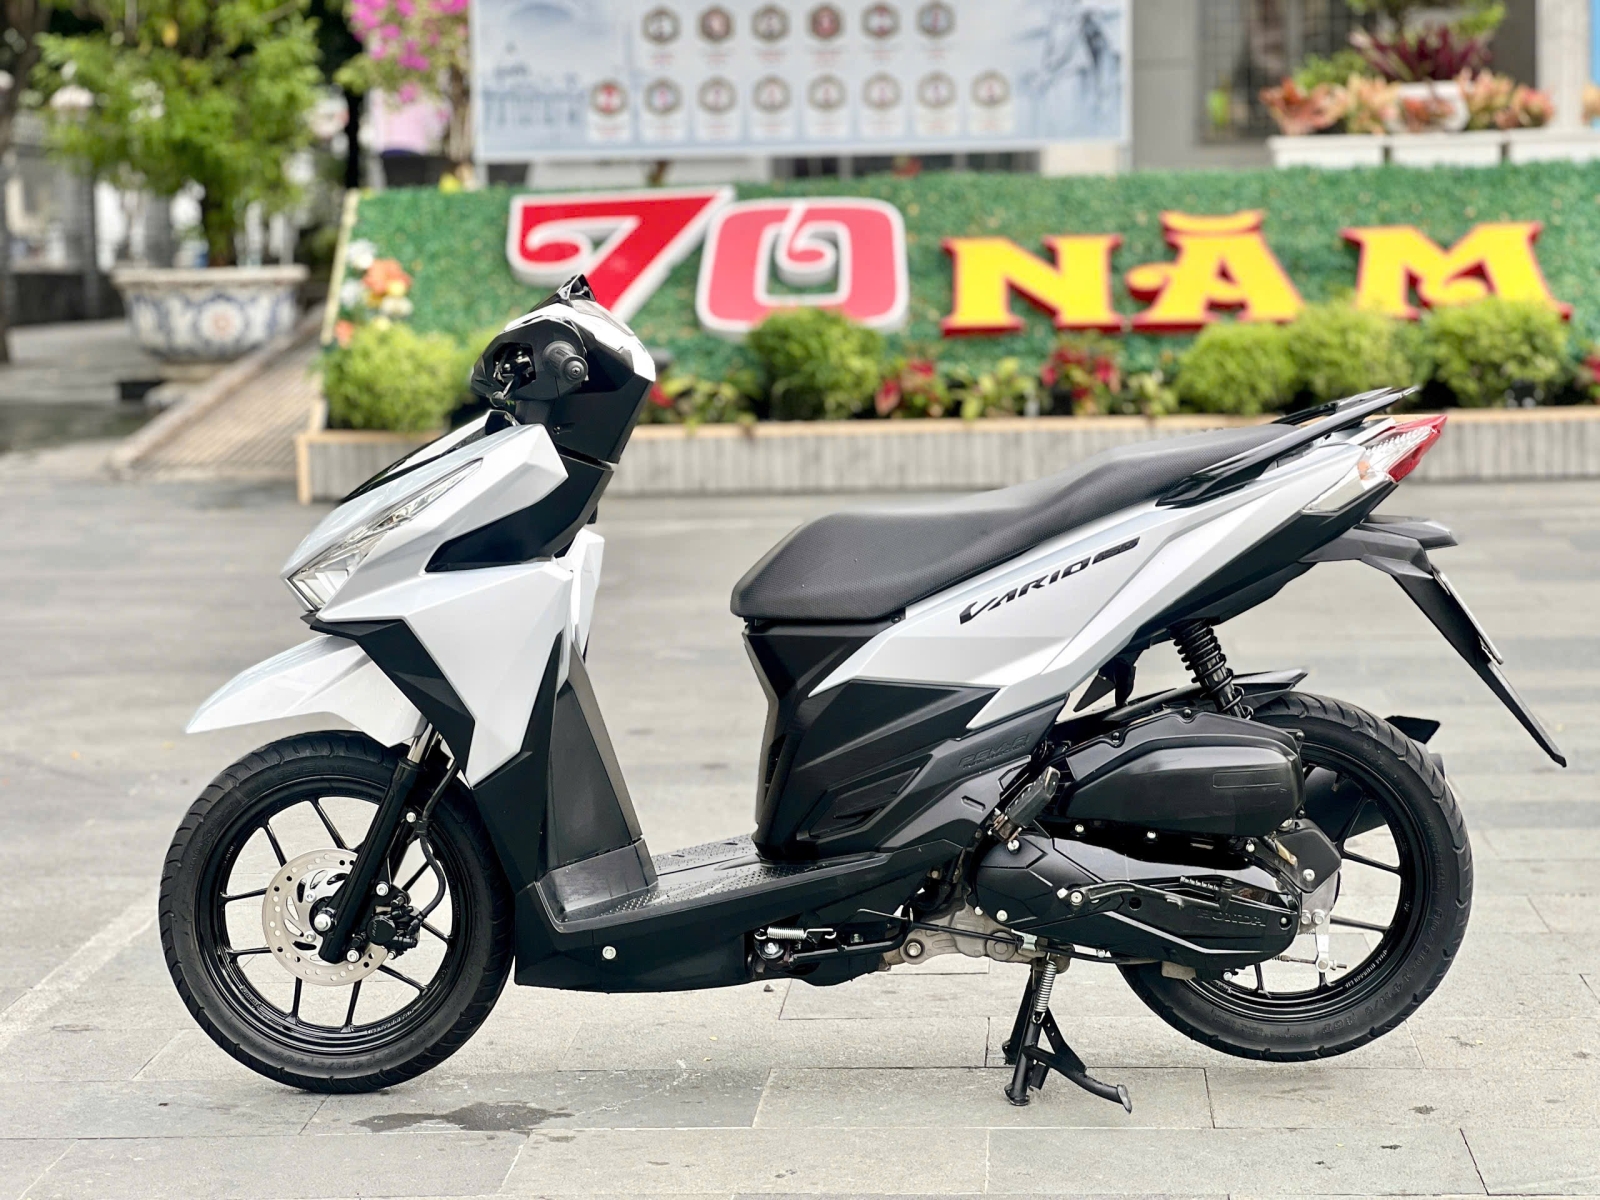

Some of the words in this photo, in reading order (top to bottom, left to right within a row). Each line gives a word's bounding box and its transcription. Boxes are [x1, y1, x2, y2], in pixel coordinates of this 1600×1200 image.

[506, 184, 910, 341] 70
[941, 209, 1573, 336] NĂM
[959, 556, 1092, 625] VARIO
